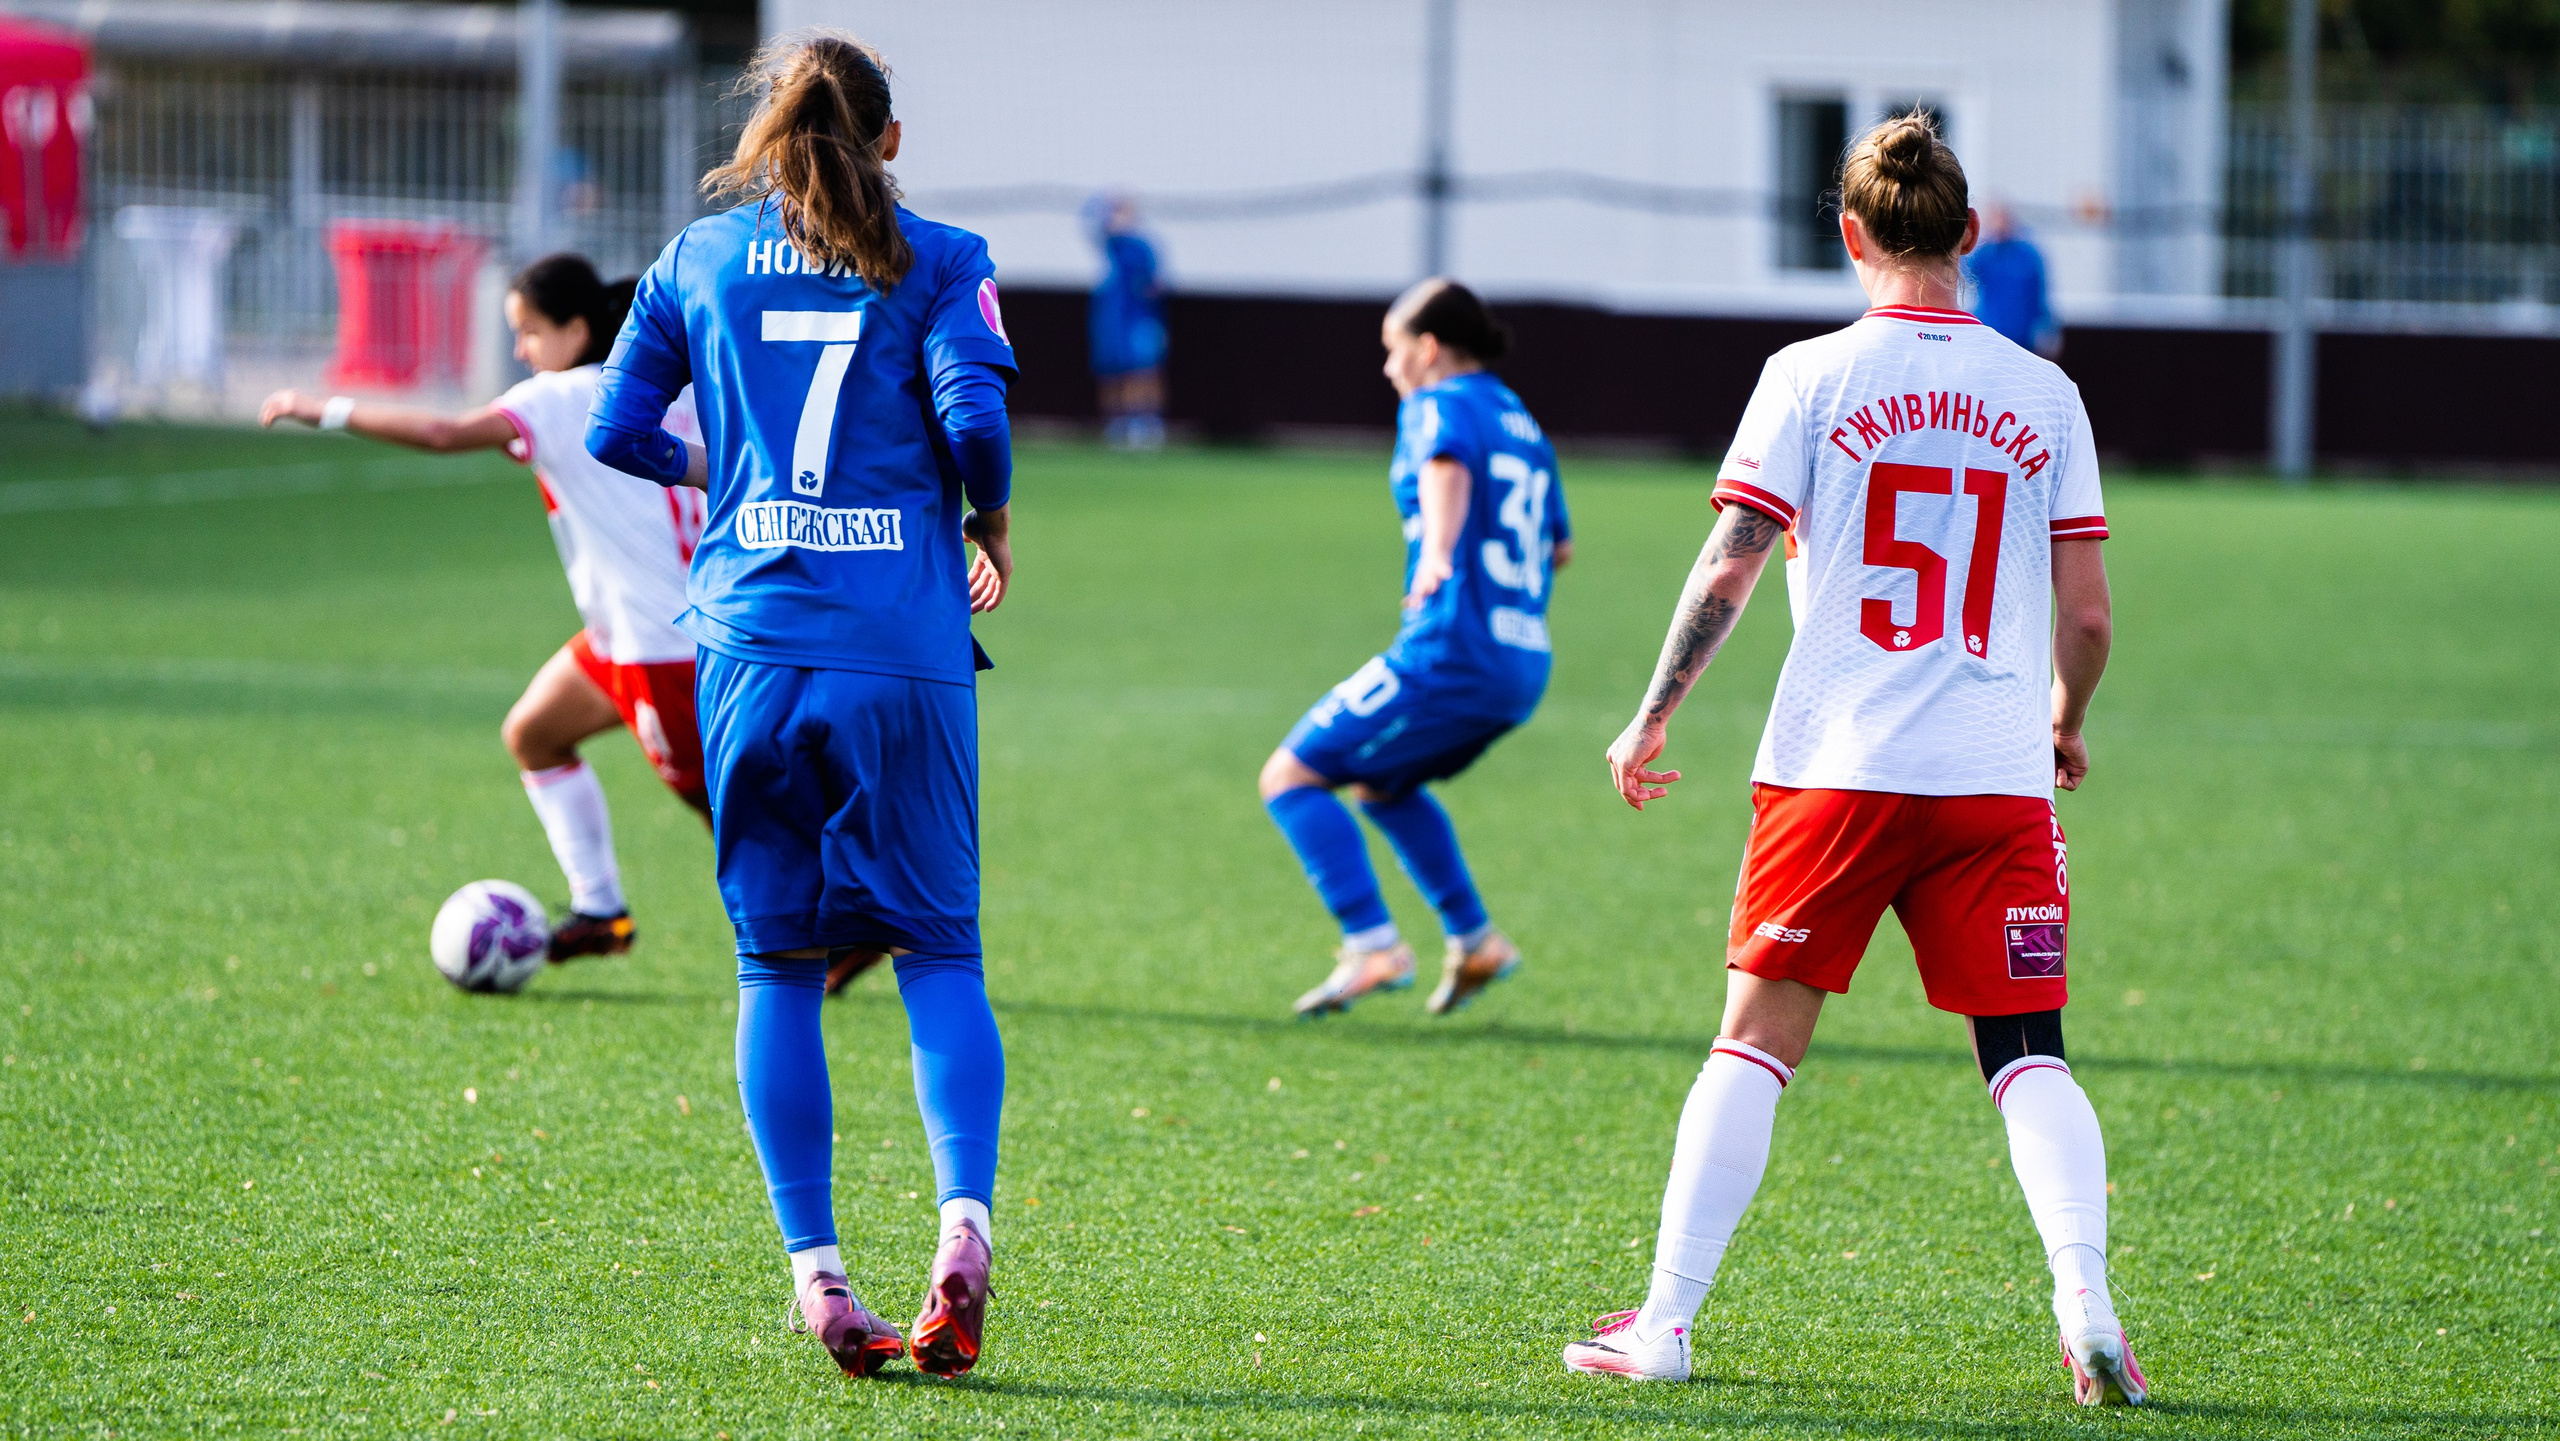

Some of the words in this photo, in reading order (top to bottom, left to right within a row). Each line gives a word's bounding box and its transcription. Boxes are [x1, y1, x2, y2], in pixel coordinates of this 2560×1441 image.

[761, 311, 860, 497] 7
[1830, 391, 2051, 481] ГЖИВИНЬСКА
[741, 504, 899, 547] СЕНЕЖСКАЯ
[1860, 462, 2008, 660] 51
[2005, 904, 2063, 921] ЛУКОЙЛ
